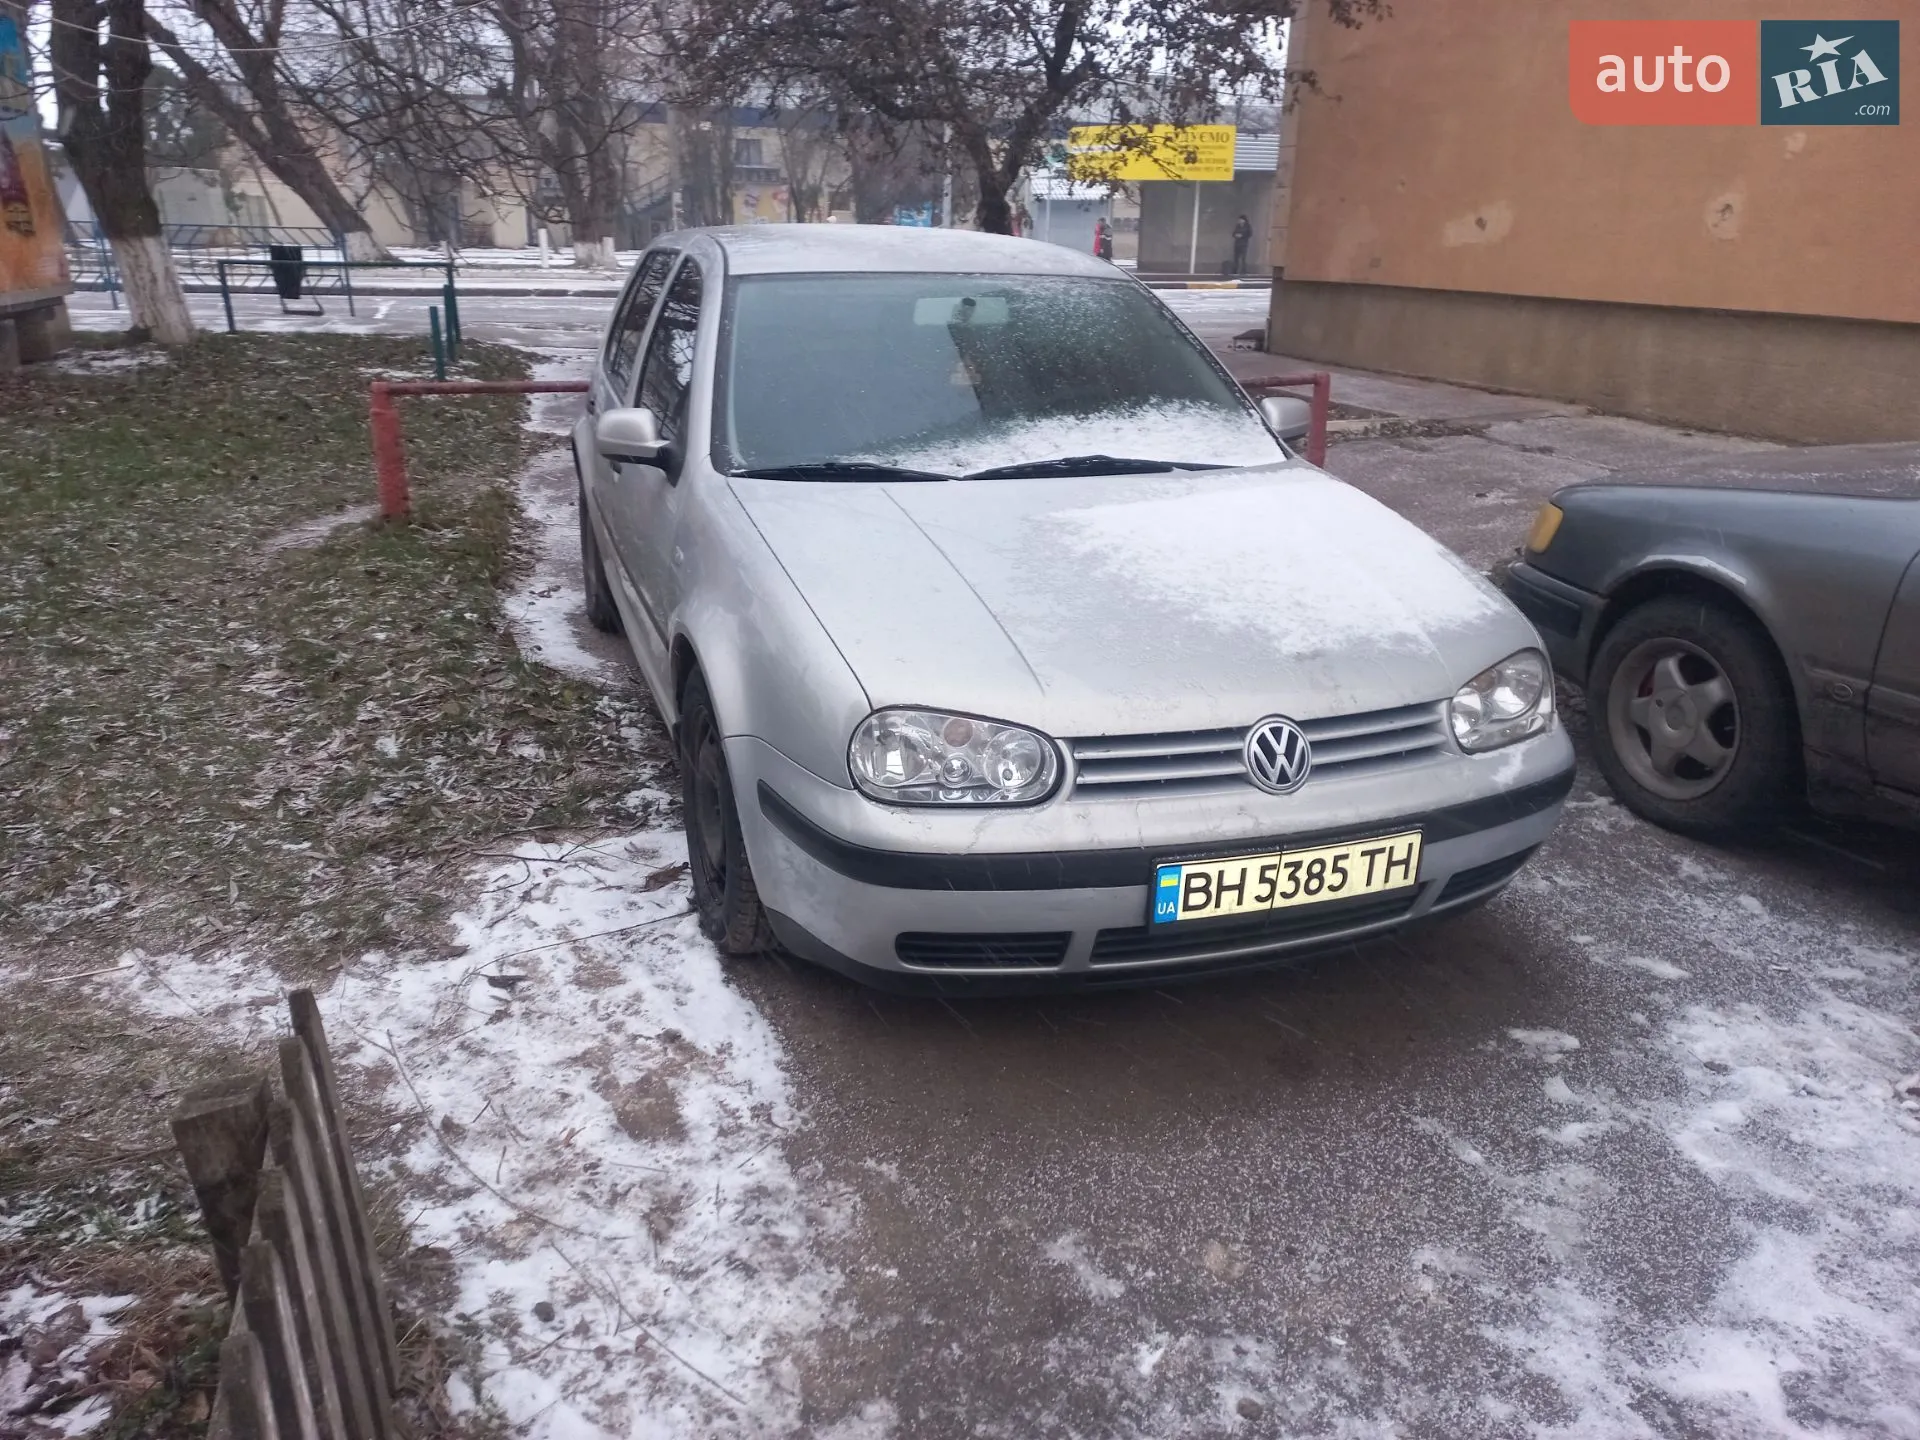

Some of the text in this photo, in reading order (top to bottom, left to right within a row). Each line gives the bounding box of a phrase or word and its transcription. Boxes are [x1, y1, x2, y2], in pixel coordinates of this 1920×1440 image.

[1181, 842, 1414, 913] BH 5385 TH
[1157, 902, 1176, 915] UA
